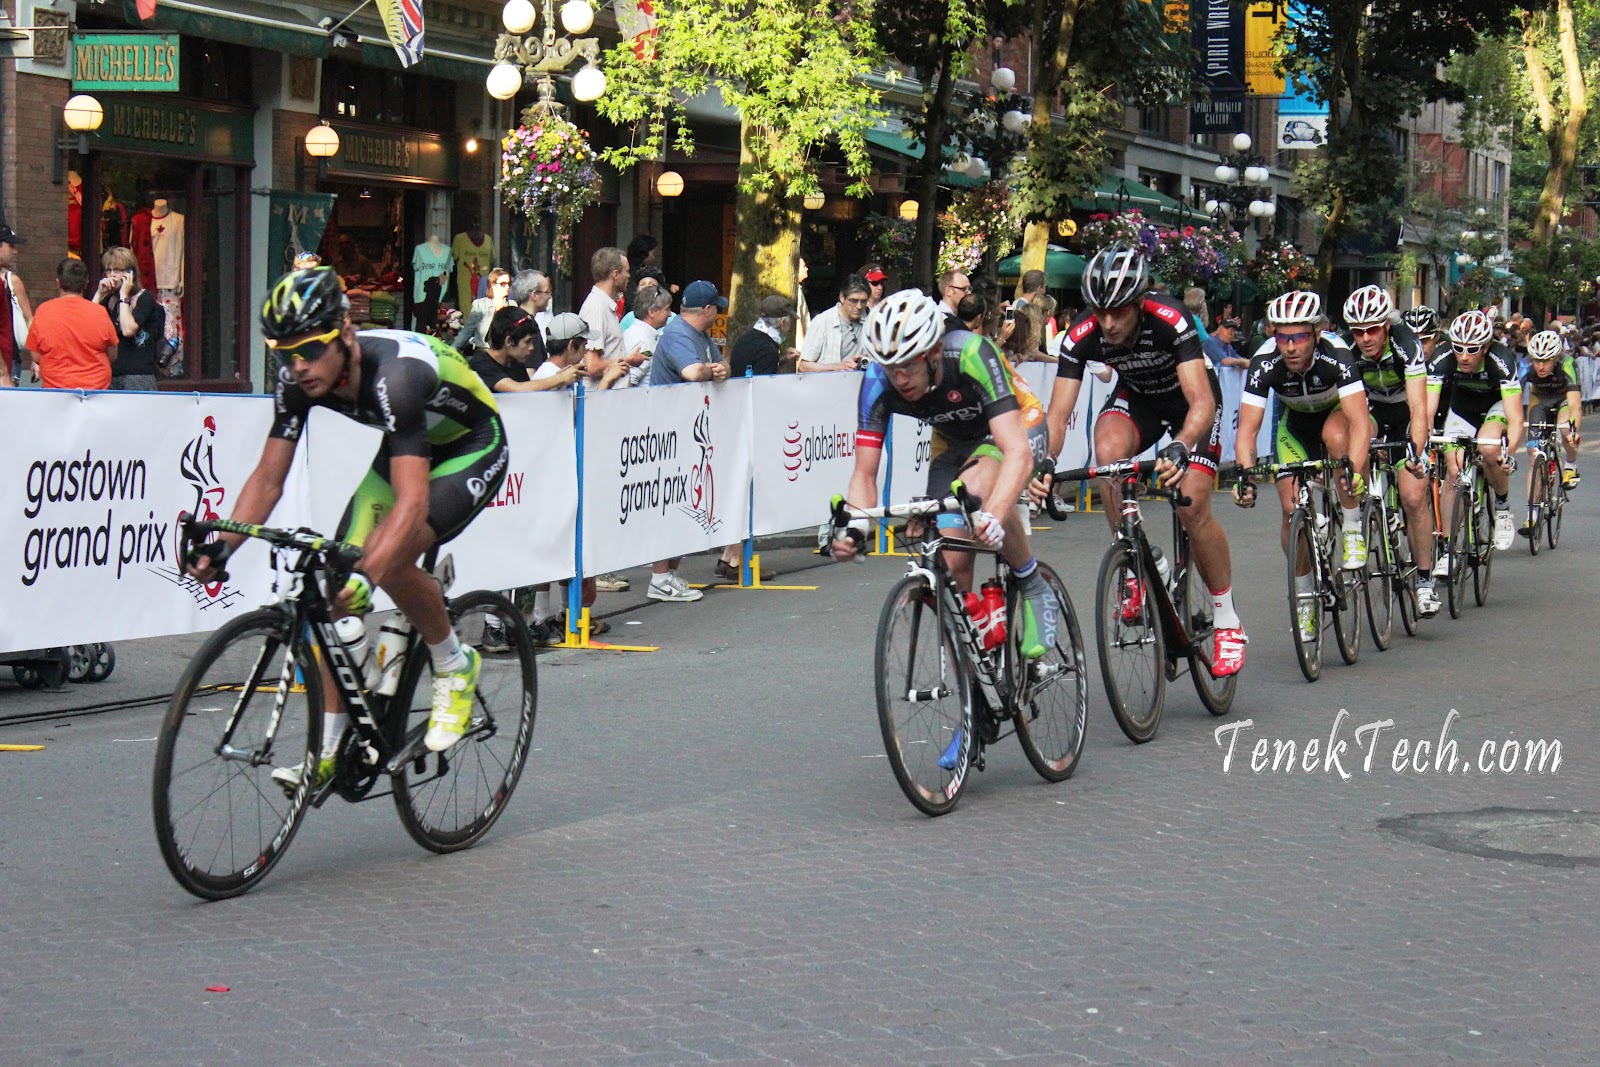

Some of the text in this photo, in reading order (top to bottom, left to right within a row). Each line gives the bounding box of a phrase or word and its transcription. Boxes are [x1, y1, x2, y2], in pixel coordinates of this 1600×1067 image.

[76, 41, 176, 82] MICHELLE'S
[1205, 37, 1232, 77] SPIRIT
[113, 104, 196, 145] MICHELLE'S
[344, 135, 411, 168] MICHELLE'S
[1320, 353, 1338, 367] ORICA
[619, 426, 678, 478] gastown
[24, 448, 147, 519] gastown
[619, 467, 688, 525] grand prix
[21, 508, 168, 587] grand prix
[317, 621, 378, 731] SCOTT
